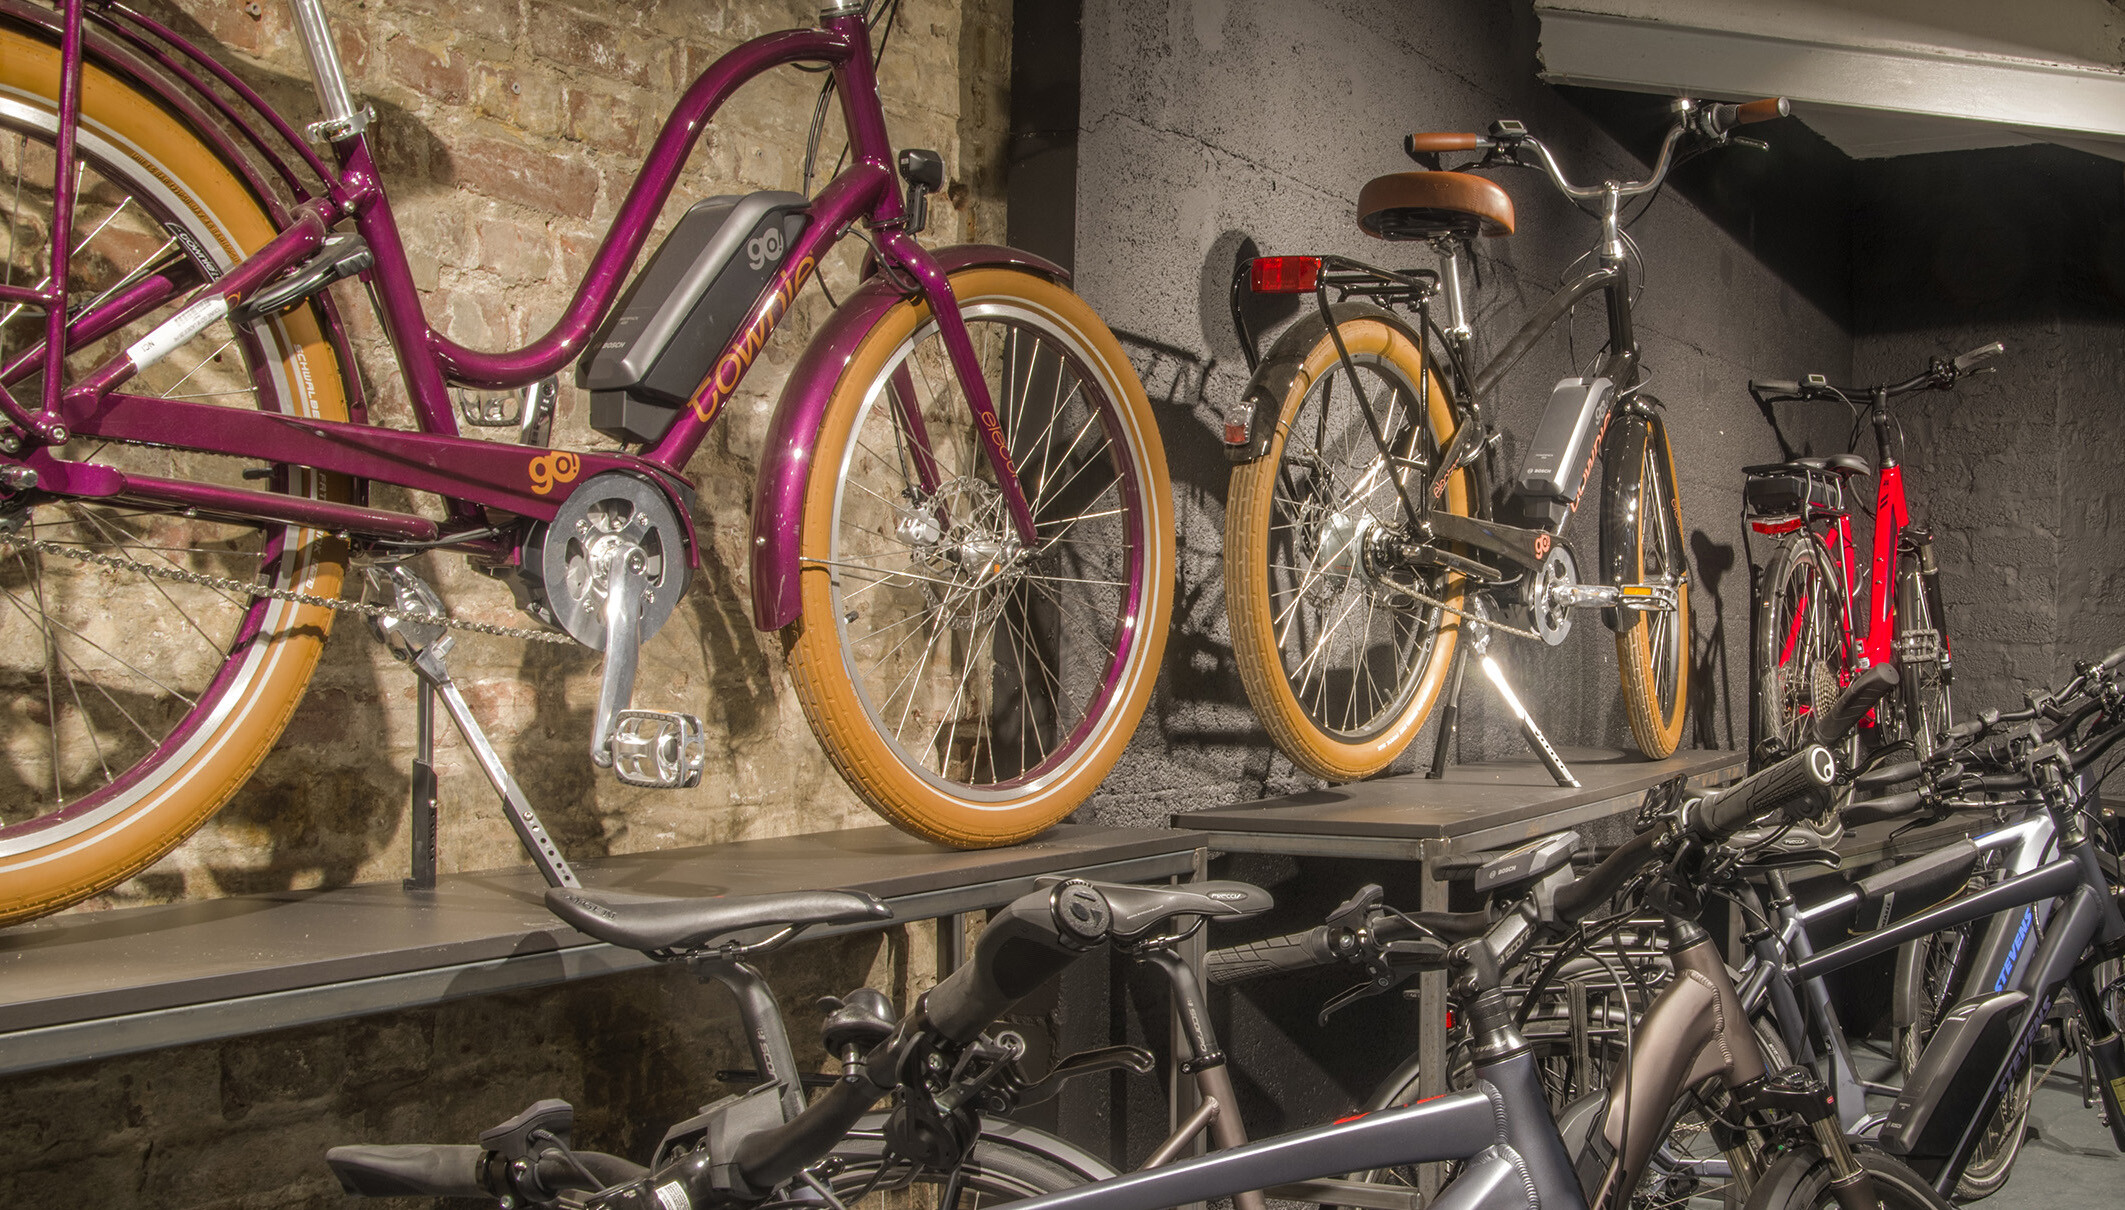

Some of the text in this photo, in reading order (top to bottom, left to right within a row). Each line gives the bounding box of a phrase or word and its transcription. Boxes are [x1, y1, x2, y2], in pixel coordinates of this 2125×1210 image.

[747, 227, 784, 271] go!
[686, 253, 815, 423] townie
[294, 344, 320, 419] SCHWALBE
[529, 450, 580, 495] go!
[1498, 865, 1517, 875] BOSCH
[1994, 906, 2033, 992] STEVENS
[760, 1042, 778, 1080] scor
[1998, 995, 2052, 1093] STEVENS
